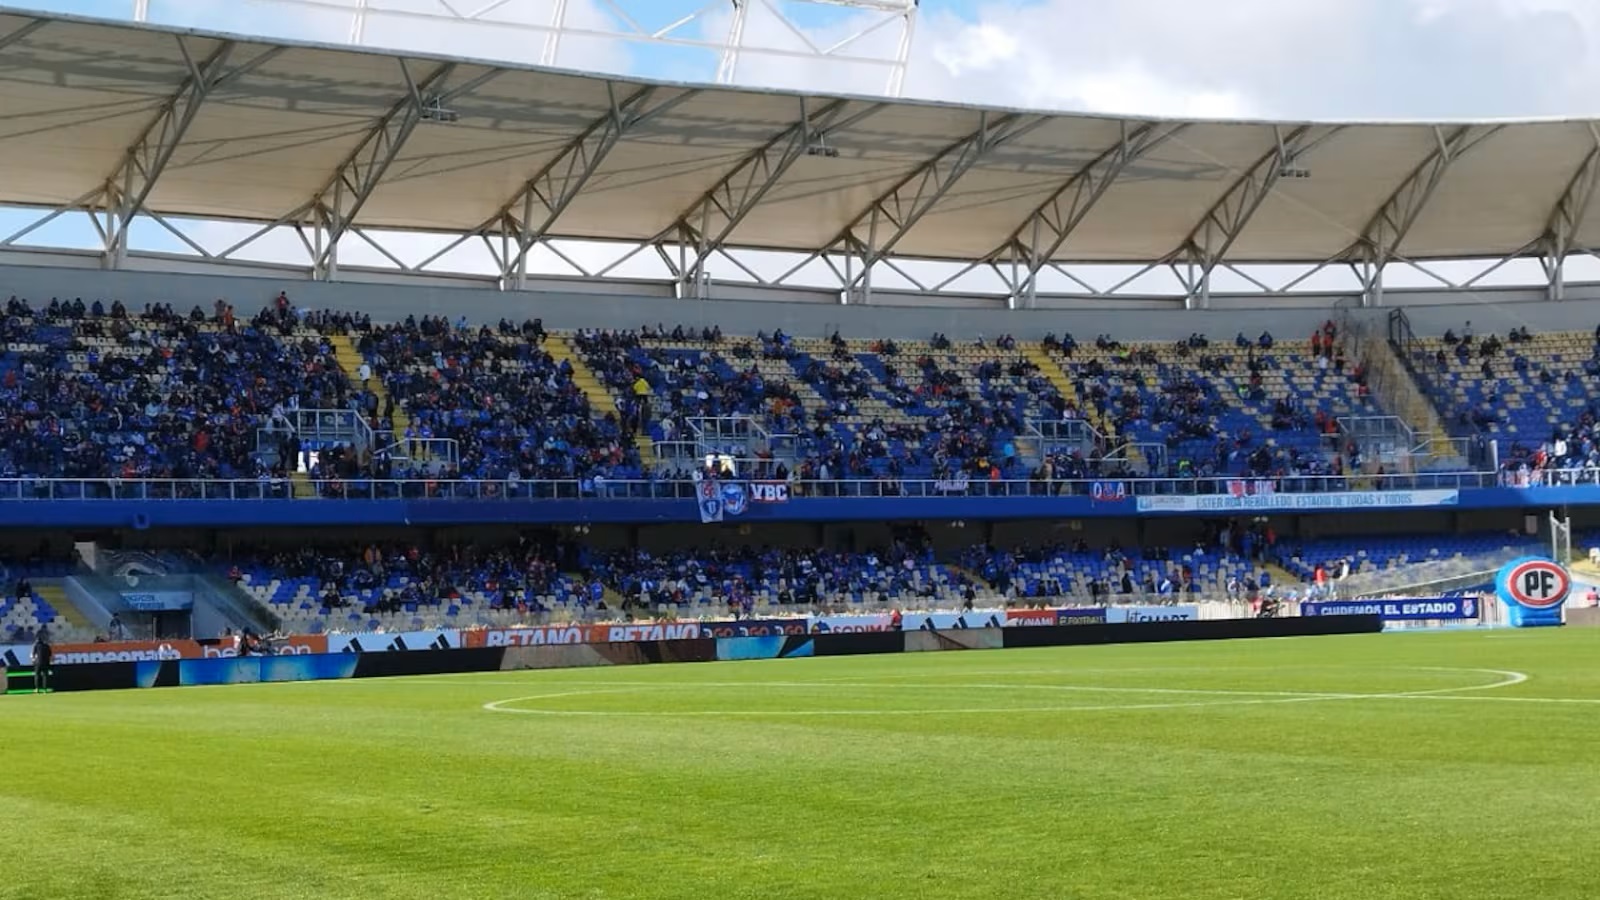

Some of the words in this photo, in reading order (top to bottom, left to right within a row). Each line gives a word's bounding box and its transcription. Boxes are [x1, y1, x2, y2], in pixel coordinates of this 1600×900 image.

[750, 484, 788, 501] VBC
[1196, 497, 1223, 509] ESTER
[1524, 570, 1555, 599] PF
[1320, 604, 1381, 616] CUIDEMOS
[1384, 604, 1400, 615] EL
[1402, 602, 1457, 614] ESTADIO
[486, 627, 581, 647] BETANO
[607, 624, 699, 642] BETANO
